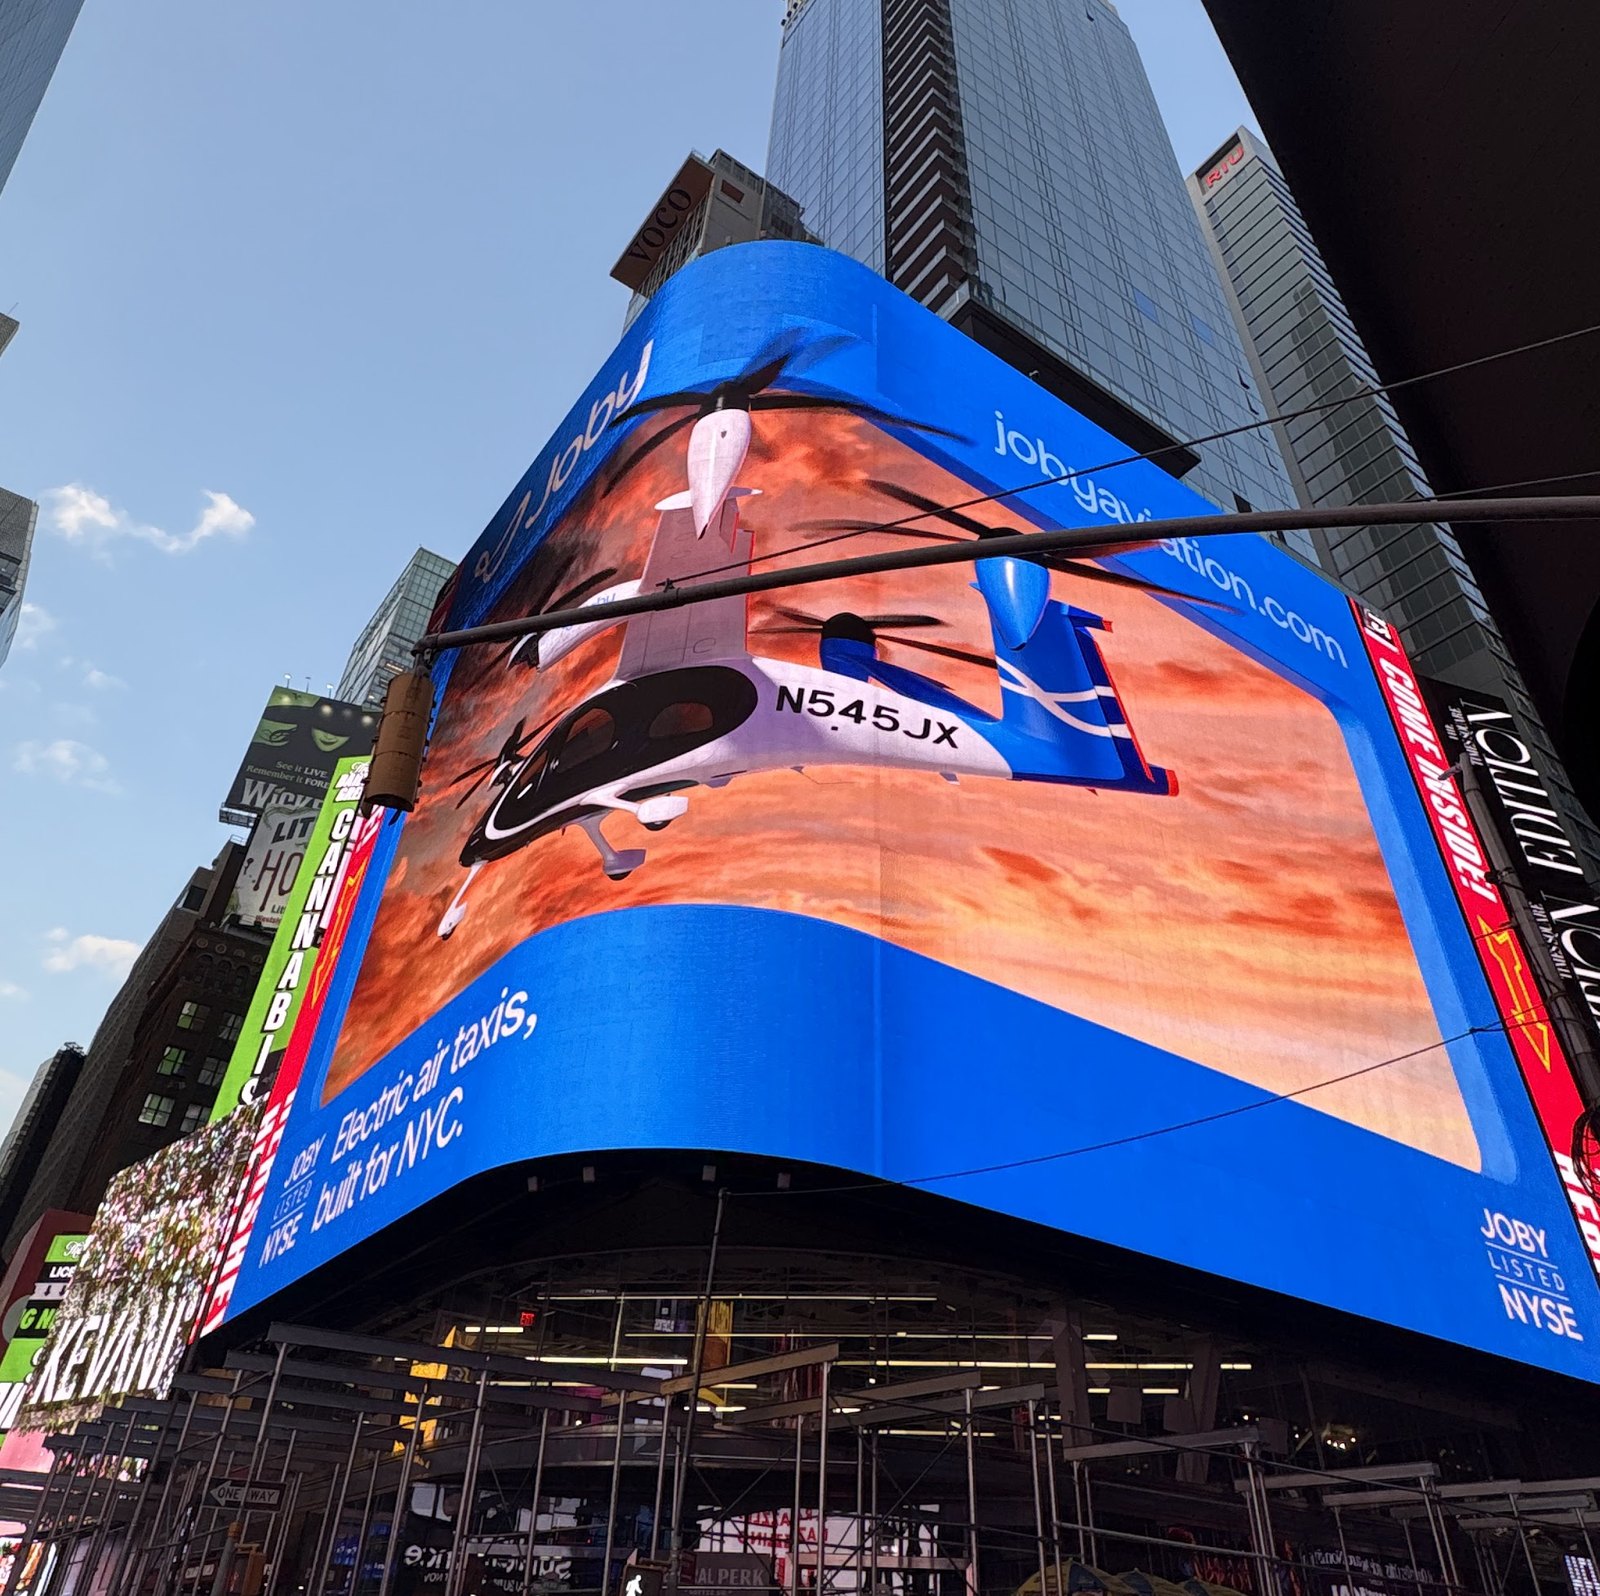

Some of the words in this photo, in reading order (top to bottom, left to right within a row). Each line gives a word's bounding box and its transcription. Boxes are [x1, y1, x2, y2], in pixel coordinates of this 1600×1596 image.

[1205, 146, 1244, 188] RIU
[775, 685, 959, 749] N545JX
[246, 765, 296, 781] Remember
[304, 778, 330, 789] FORE
[275, 761, 293, 770] See
[1379, 657, 1440, 756] COME
[1417, 761, 1498, 903] INSIDE!
[1459, 698, 1584, 875] EDITION
[271, 815, 316, 844] LIT
[240, 808, 355, 1105] CANNABIS
[331, 1069, 413, 1164] Electric
[413, 1039, 449, 1103] air
[450, 987, 538, 1075] taxis,
[284, 1133, 326, 1189] JOBY
[311, 1163, 361, 1233] built
[360, 1142, 400, 1201] for
[396, 1086, 463, 1177] NYC.
[273, 1180, 312, 1220] LISTED
[258, 1212, 303, 1269] NYSE
[1480, 1208, 1548, 1258] JOBY
[1487, 1250, 1565, 1291] LISTED
[1498, 1283, 1584, 1341] NYSE
[28, 1297, 187, 1404] KEVANI
[217, 1486, 240, 1499] ONE
[250, 1490, 276, 1502] WAY
[717, 1567, 766, 1587] PERK
